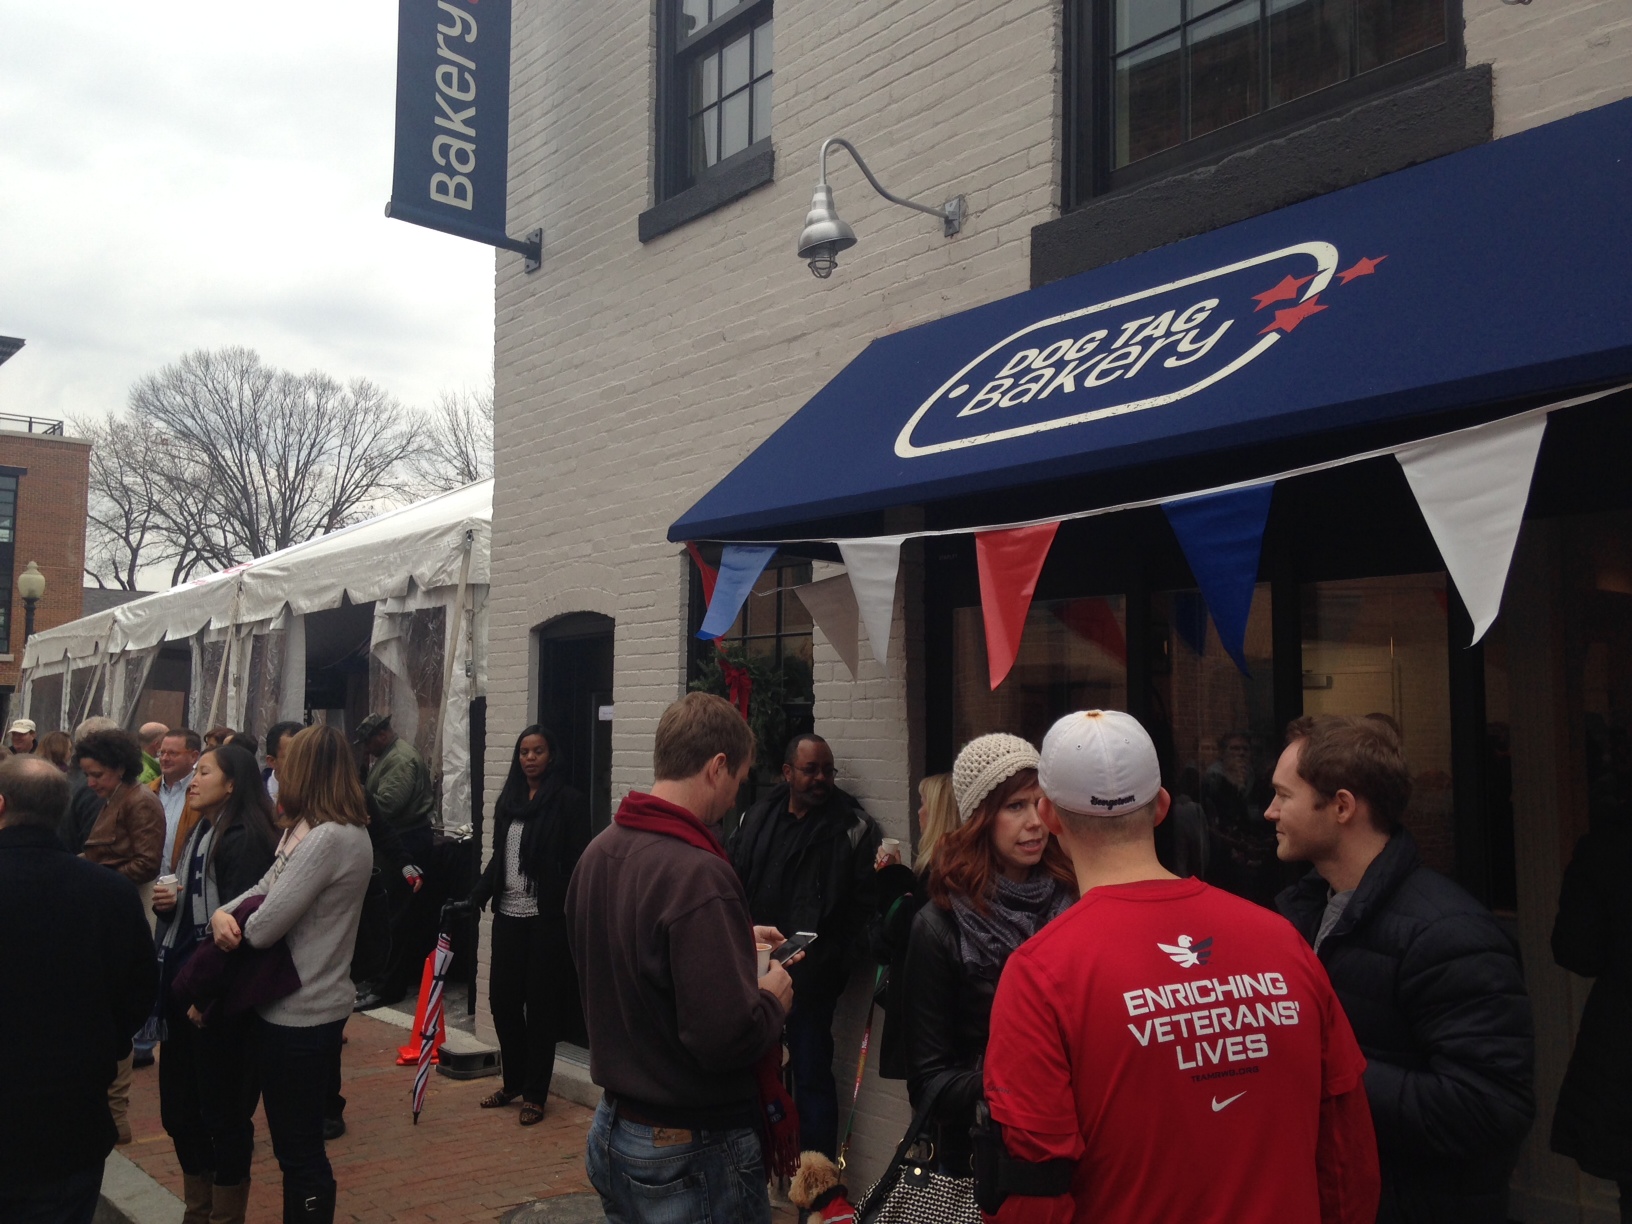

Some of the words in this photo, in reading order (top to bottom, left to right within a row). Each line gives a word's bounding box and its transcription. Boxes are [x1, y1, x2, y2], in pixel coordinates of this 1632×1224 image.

[430, 0, 478, 211] Bakery
[956, 319, 1235, 418] Bakery
[994, 328, 1108, 379] DOG
[1110, 298, 1220, 346] TAG
[1123, 972, 1288, 1017] ENRICHING
[1127, 1001, 1300, 1047] VETERANS'
[1176, 1033, 1269, 1070] LIVES
